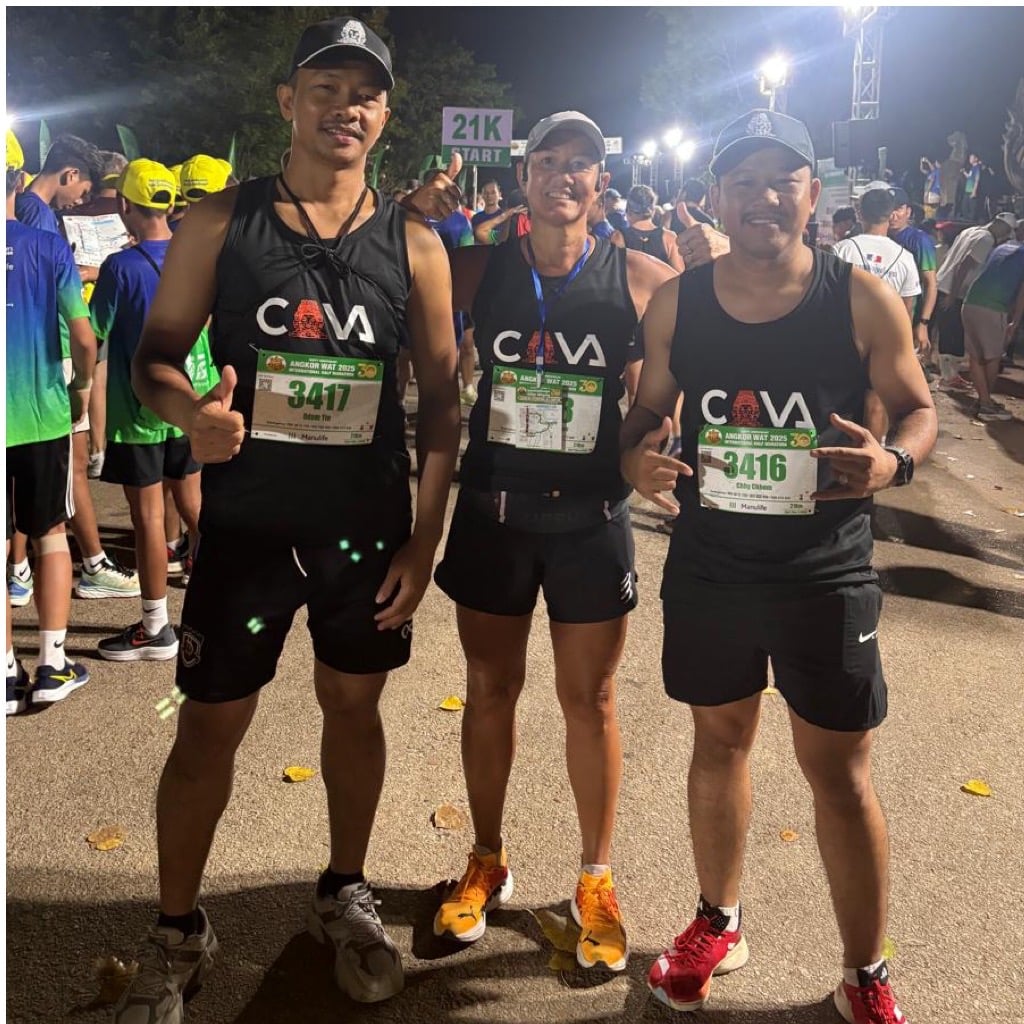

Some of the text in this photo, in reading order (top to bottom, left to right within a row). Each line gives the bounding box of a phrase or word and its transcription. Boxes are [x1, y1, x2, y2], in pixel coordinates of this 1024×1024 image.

[451, 113, 503, 141] 21K
[321, 363, 337, 371] WAT
[338, 364, 356, 372] 2025
[287, 380, 352, 412] 3417
[752, 433, 769, 441] WAT
[770, 434, 787, 442] 2025
[723, 450, 787, 482] 3416
